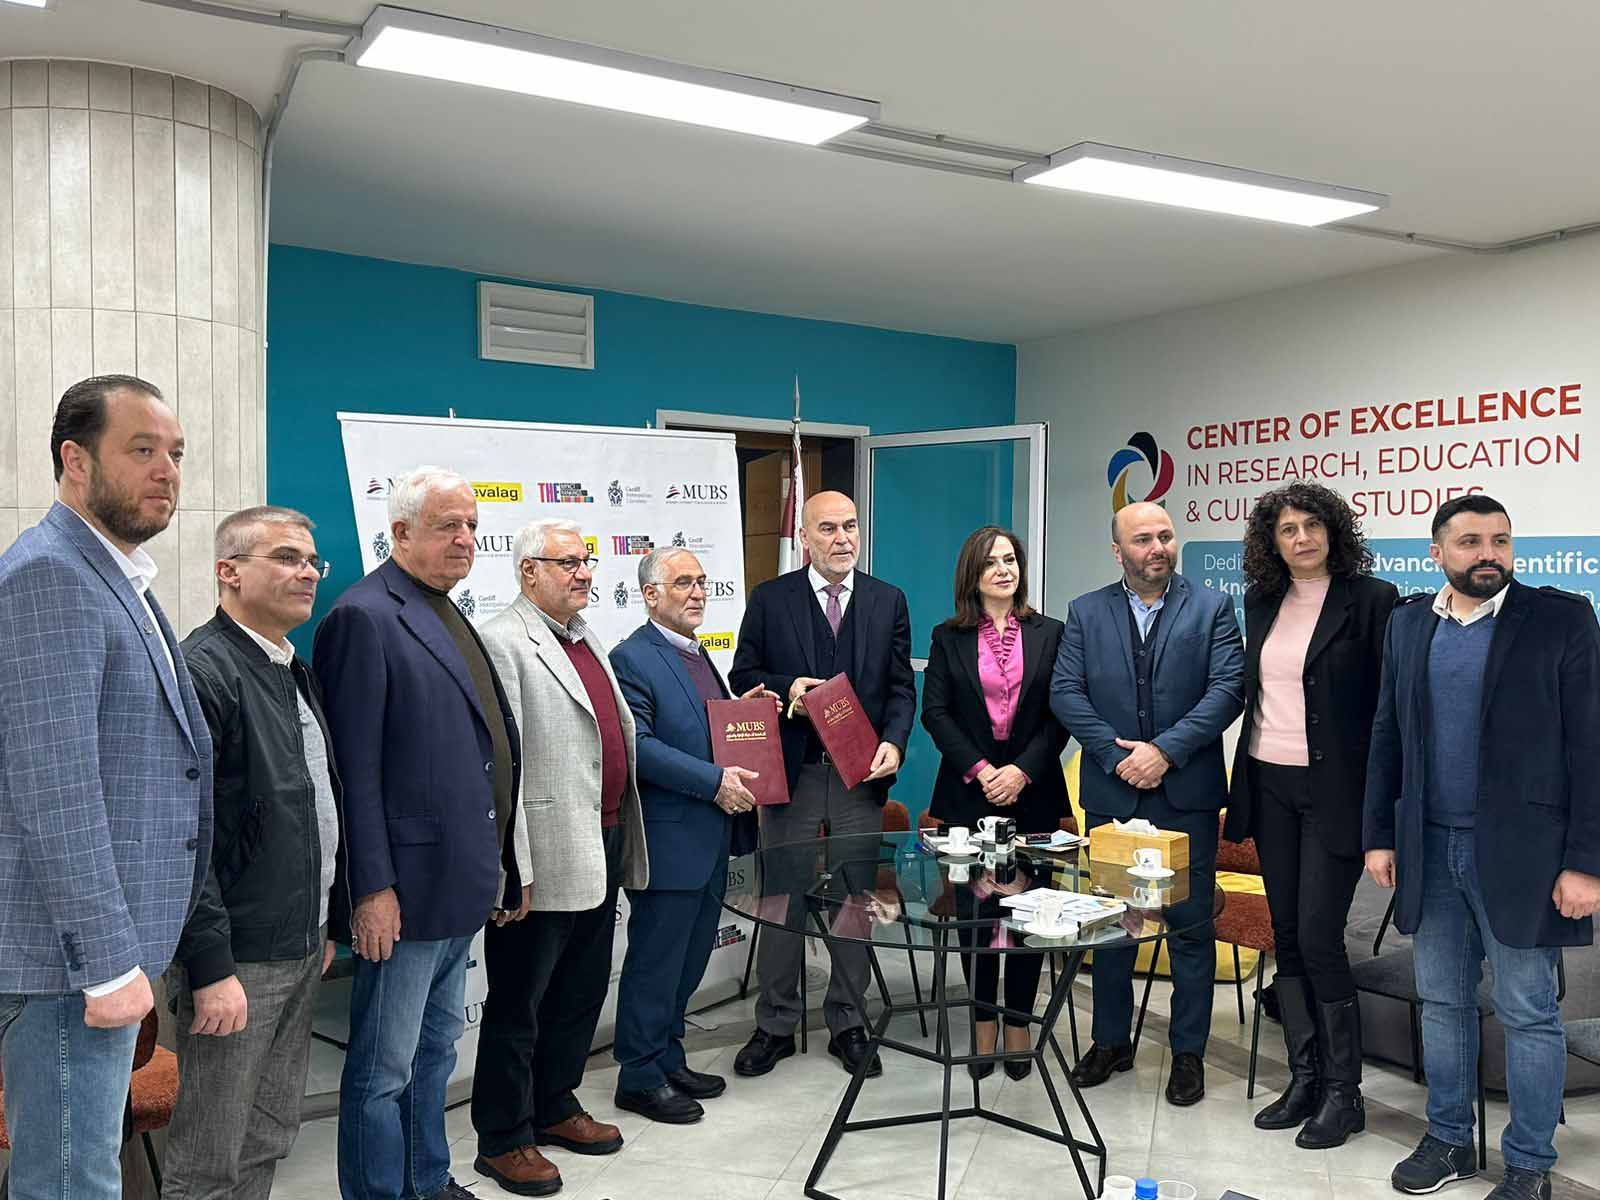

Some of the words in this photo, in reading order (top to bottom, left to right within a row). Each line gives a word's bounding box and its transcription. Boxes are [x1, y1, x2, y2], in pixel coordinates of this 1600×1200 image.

[1187, 417, 1290, 450] CENTER
[1299, 409, 1341, 438] OF
[1351, 383, 1582, 435] EXCELLENCE
[1187, 462, 1210, 487] IN
[1219, 450, 1368, 485] RESEARCH,
[1378, 433, 1580, 474] EDUCATION
[537, 483, 560, 503] THE
[683, 484, 728, 500] MUBS
[1186, 500, 1200, 522] &
[611, 536, 631, 555] THE
[1204, 553, 1244, 570] Dedi
[1513, 550, 1599, 574] entific
[704, 581, 734, 597] UBS
[736, 721, 766, 731] MUBS
